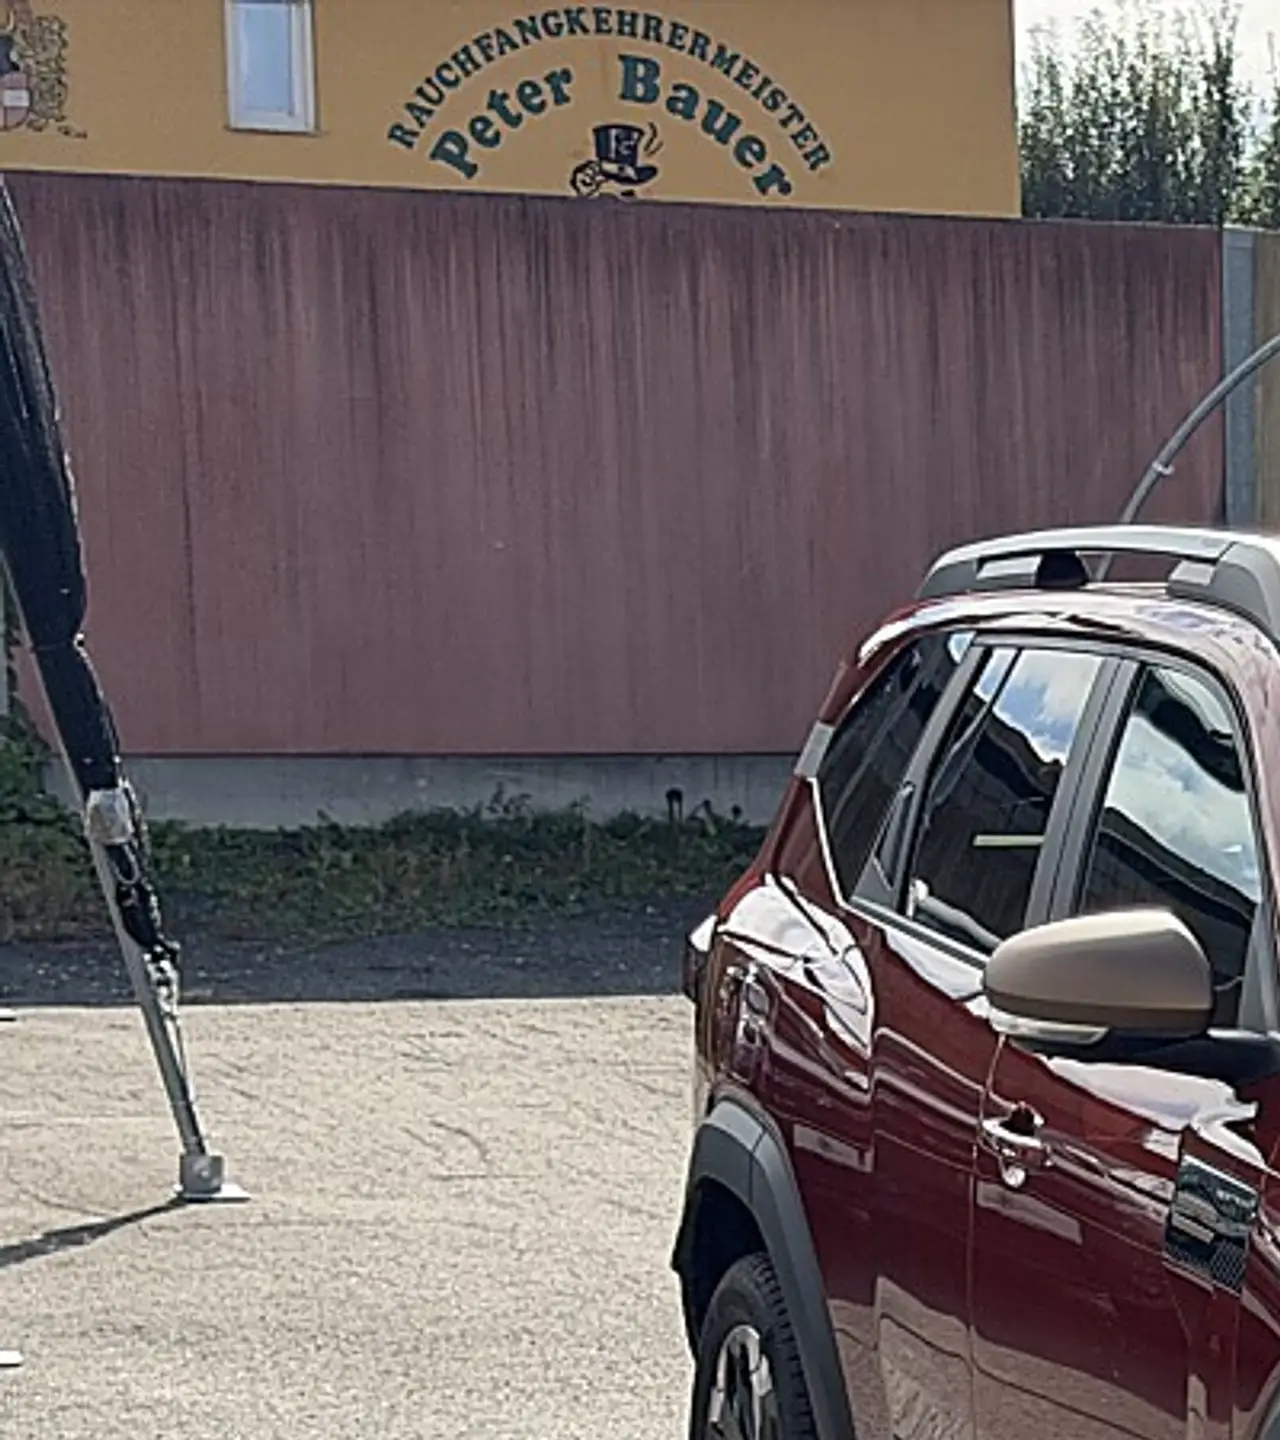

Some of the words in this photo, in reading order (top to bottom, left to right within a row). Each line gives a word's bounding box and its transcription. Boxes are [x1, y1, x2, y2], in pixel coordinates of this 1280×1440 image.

[388, 7, 829, 171] RAUCHFANGKEHRERMEISTER
[430, 67, 573, 179] Peter
[617, 55, 792, 197] Bauer
